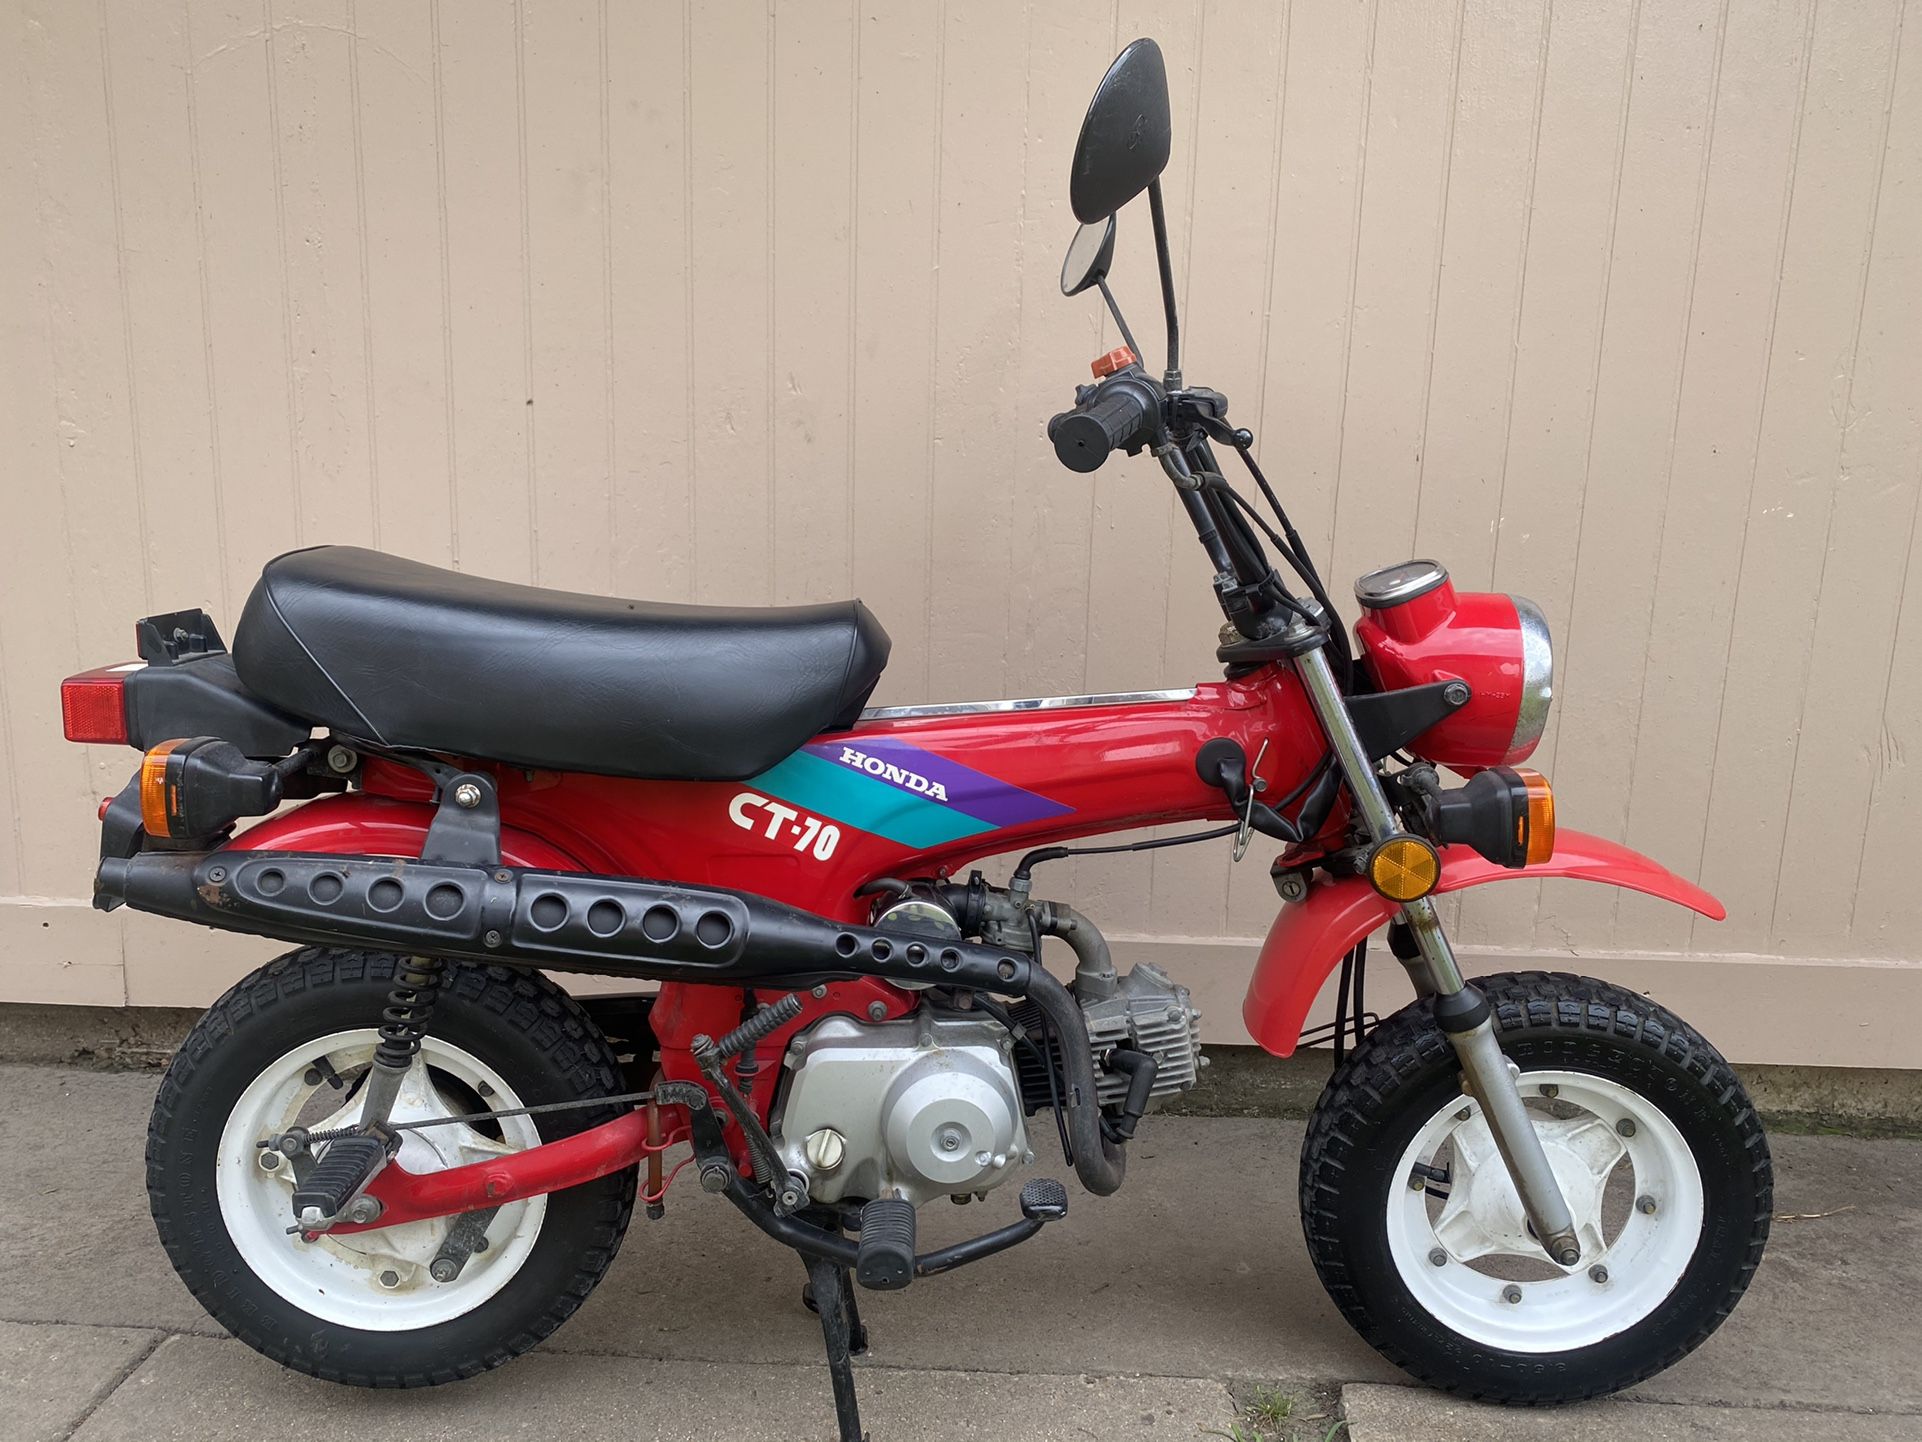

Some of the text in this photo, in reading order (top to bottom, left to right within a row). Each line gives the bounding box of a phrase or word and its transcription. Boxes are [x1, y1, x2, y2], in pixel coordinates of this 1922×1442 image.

[839, 747, 948, 802] HONDA
[728, 792, 841, 862] CT-70
[1500, 1041, 1711, 1123] RIDGESTONE
